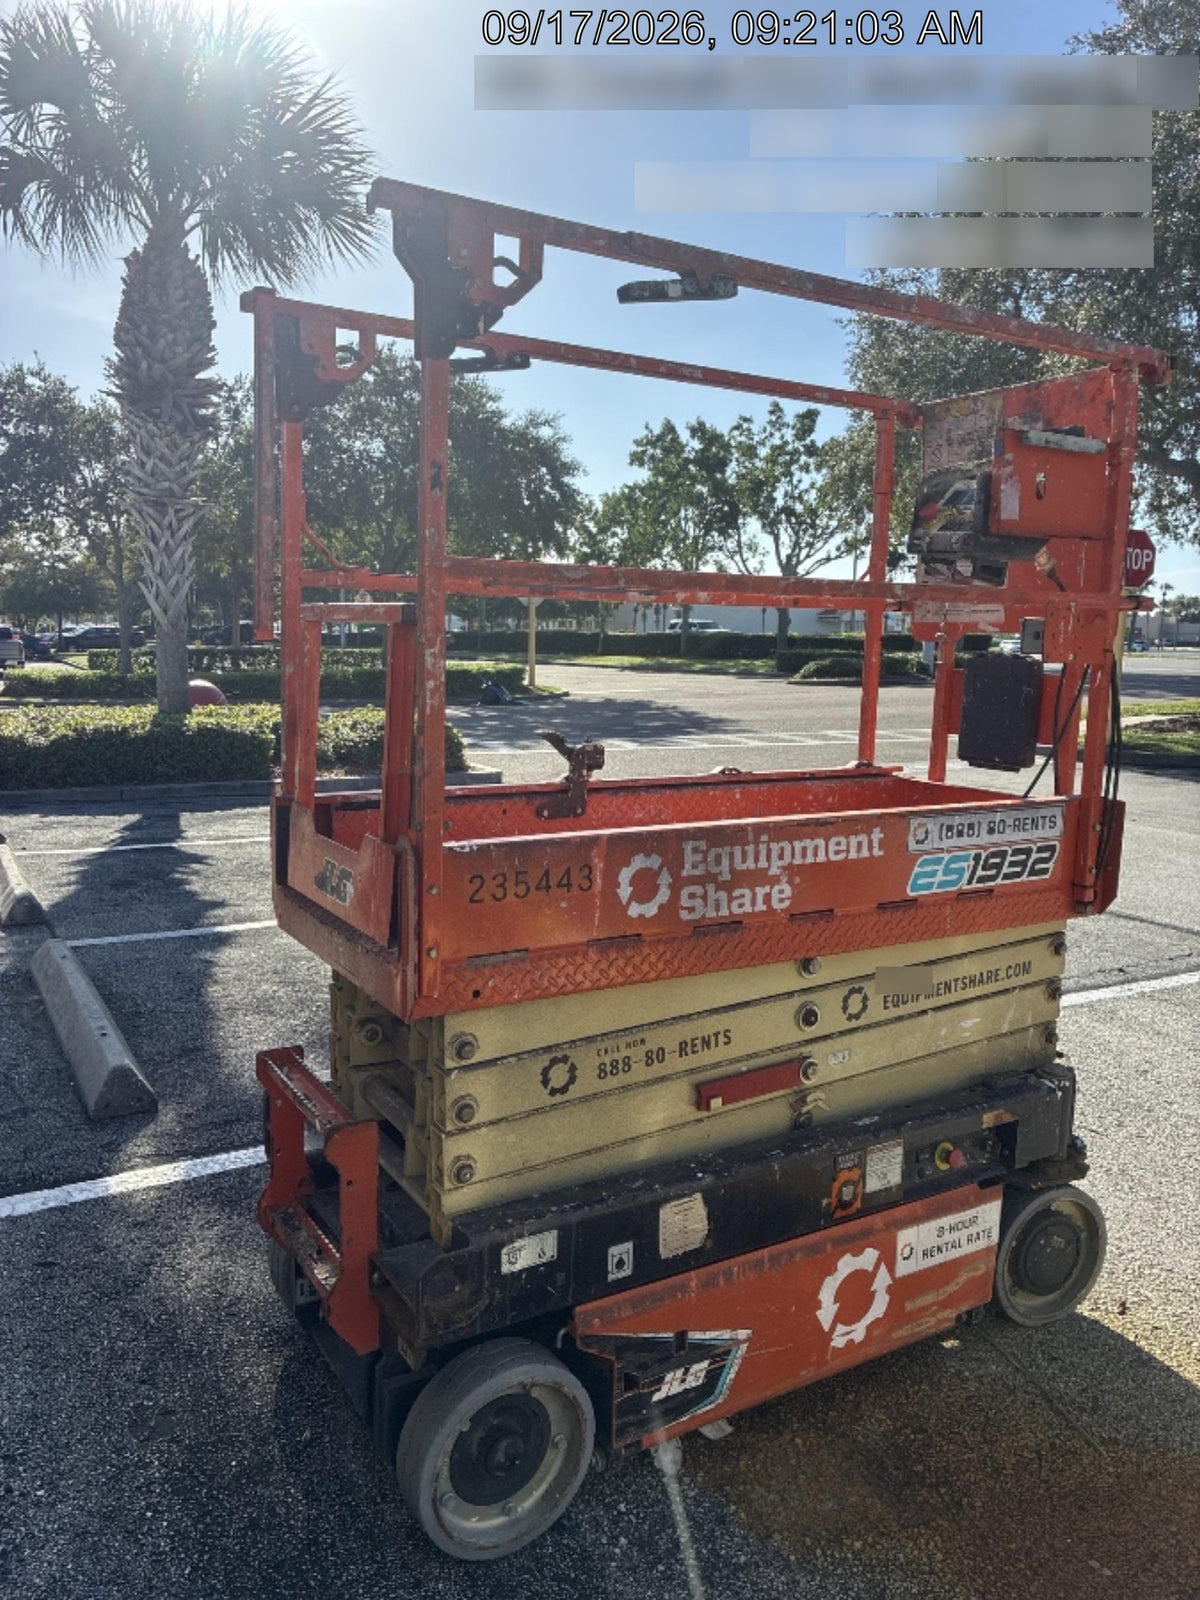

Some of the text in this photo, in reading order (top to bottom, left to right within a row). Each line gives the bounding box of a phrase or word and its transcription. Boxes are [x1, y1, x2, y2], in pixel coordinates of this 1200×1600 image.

[1125, 547, 1153, 570] TOP
[986, 814, 1058, 836] 80-RENTS
[680, 826, 885, 882] Equipment
[908, 841, 1060, 895] ES1932
[468, 863, 593, 903] 235443
[679, 880, 793, 921] Share
[597, 1028, 732, 1080] 888-80-RENTS
[922, 1226, 993, 1261] RENTAL RATE
[936, 1215, 979, 1239] 8-HOUR
